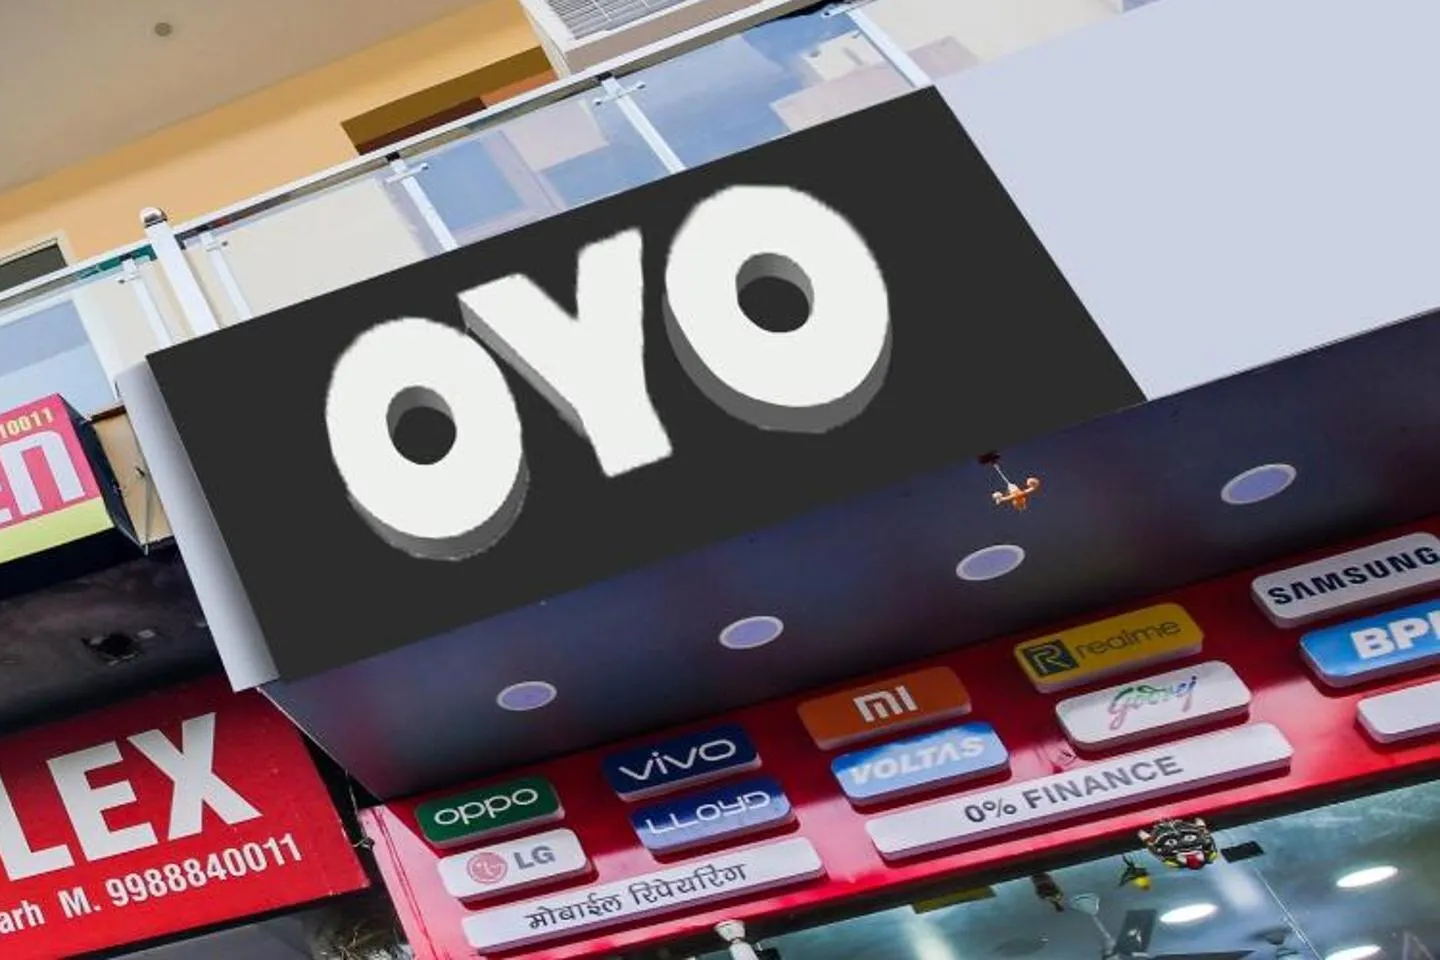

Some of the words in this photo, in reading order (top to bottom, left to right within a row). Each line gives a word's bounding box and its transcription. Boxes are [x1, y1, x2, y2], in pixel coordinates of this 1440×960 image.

[325, 183, 893, 560] OYO
[1268, 546, 1440, 606] SAMSUNG
[1075, 621, 1181, 659] realme
[618, 739, 736, 780] vivo
[849, 736, 985, 785] VOLTAS
[434, 788, 538, 825] oppo
[964, 798, 1017, 823] 0%
[1022, 756, 1184, 810] FINANCE
[646, 790, 771, 834] LLOYD
[58, 889, 100, 920] M.
[106, 833, 303, 908] 9988840011
[513, 846, 556, 870] LG
[524, 892, 622, 929] मोबाईल
